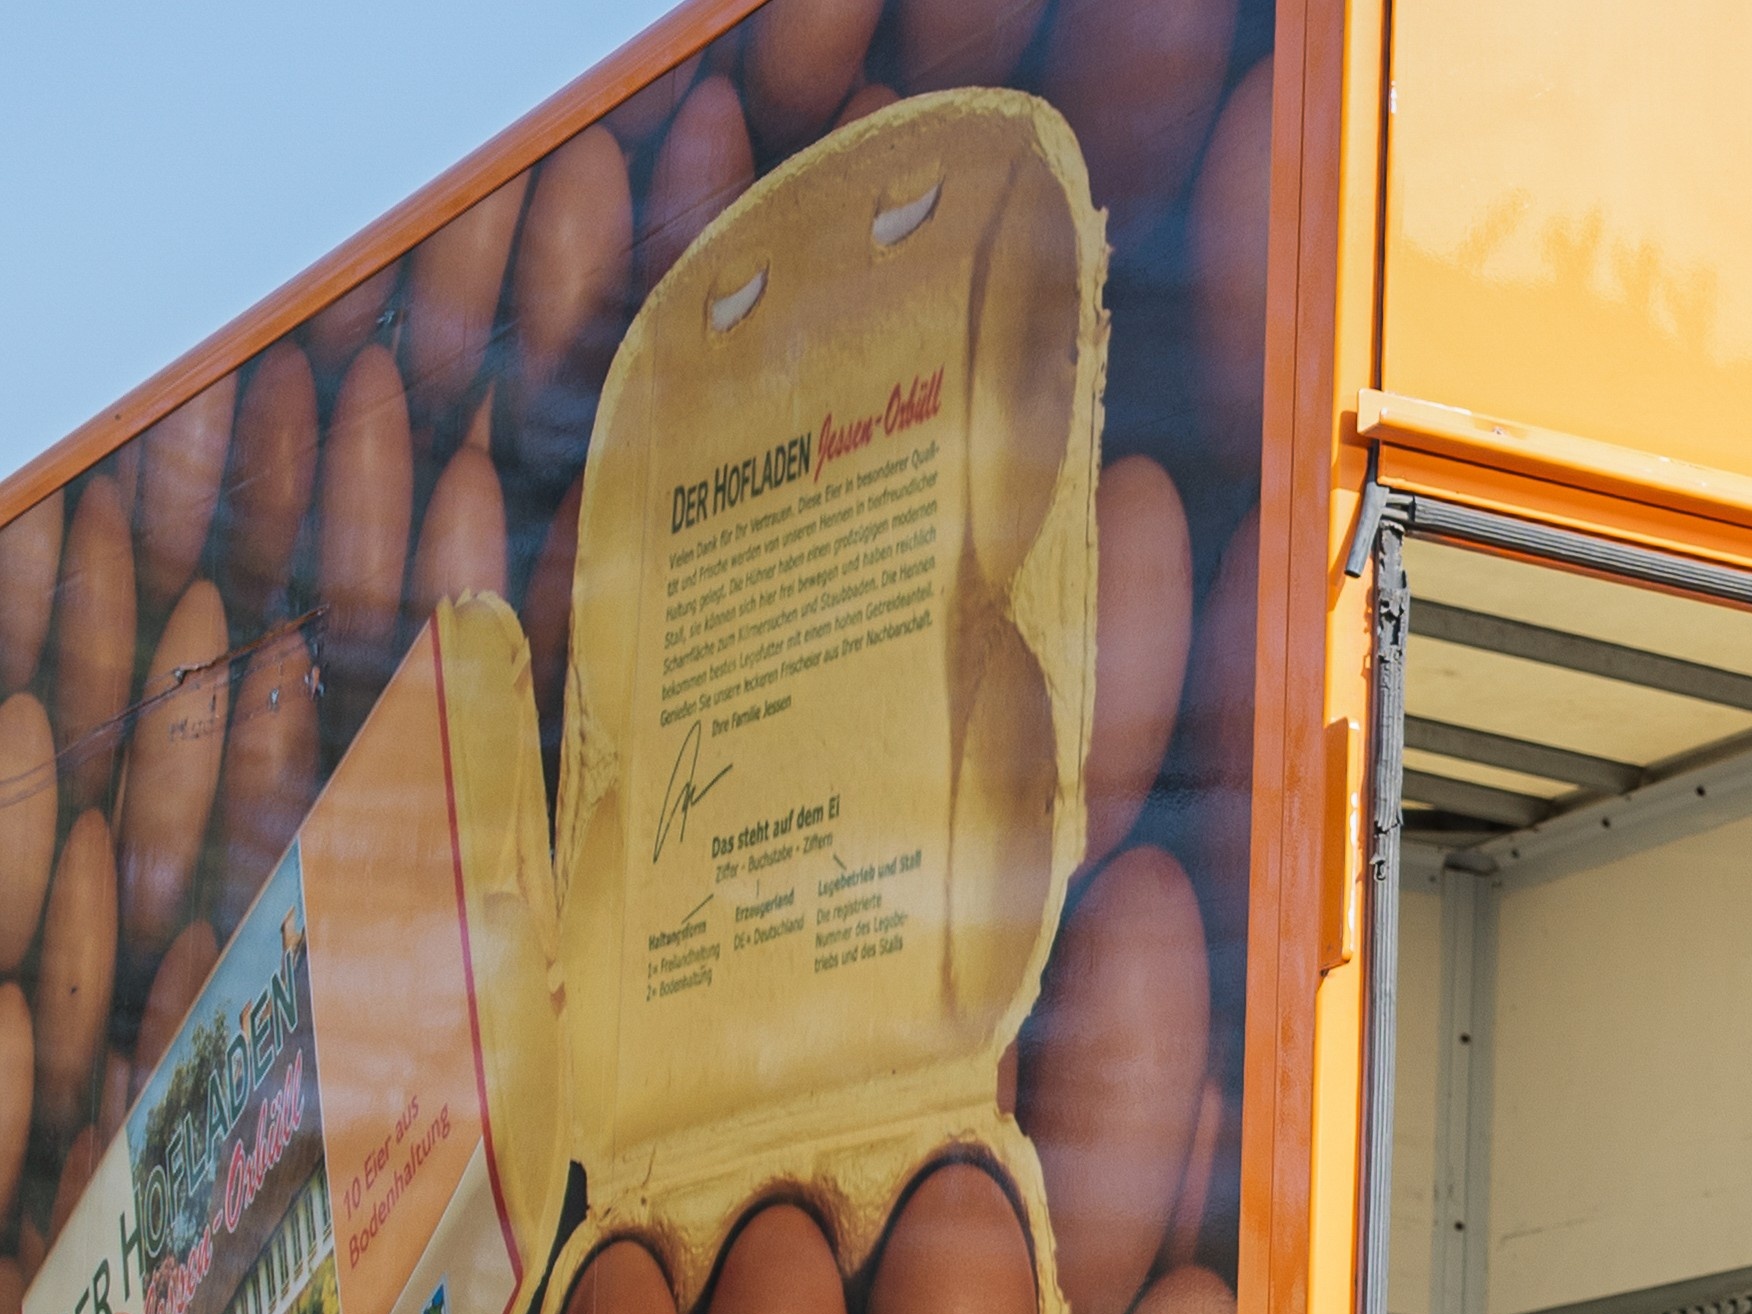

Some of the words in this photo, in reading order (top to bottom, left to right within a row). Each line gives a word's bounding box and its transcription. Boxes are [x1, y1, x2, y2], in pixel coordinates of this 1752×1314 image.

[672, 480, 709, 534] DER
[713, 432, 811, 516] HOFLADEN
[814, 362, 945, 484] Jessen-Oxbüll
[669, 548, 694, 570] Vielen
[696, 535, 717, 559] Dank
[720, 529, 733, 546] für
[735, 523, 748, 540] Ihr
[797, 492, 822, 514] Diese
[824, 483, 843, 503] Eier
[681, 569, 697, 591] und
[730, 544, 761, 567] werden
[764, 536, 779, 553] von
[782, 520, 816, 547] unseren
[819, 506, 853, 529] Hennen
[729, 577, 743, 595] Die
[745, 564, 776, 587] Hühner
[778, 552, 805, 573] haben
[806, 542, 831, 562] einen
[891, 498, 938, 528] modernen
[717, 632, 736, 653] zum
[800, 596, 818, 618] und
[881, 569, 897, 588] Die
[899, 555, 936, 580] Hennen
[738, 595, 756, 617] sich
[759, 590, 777, 608] hier
[779, 583, 794, 598] frei
[797, 565, 838, 593] bewegen
[841, 554, 860, 576] und
[862, 544, 893, 567] haben
[803, 621, 831, 643] einem
[834, 609, 863, 631] hohen
[699, 693, 712, 712] Sie
[713, 682, 741, 706] unsere
[823, 645, 839, 664] aus
[841, 636, 863, 657] Ihrer
[711, 718, 729, 738] Ihre
[731, 706, 761, 729] Familie
[711, 835, 734, 859] Das
[737, 819, 769, 850] steht
[772, 808, 794, 838] auf
[796, 805, 824, 830] dem
[715, 861, 739, 884] Ziffer
[747, 845, 793, 874] Buchstabe
[802, 832, 833, 855] Ziffern
[817, 864, 875, 897] Legebetrieb
[877, 857, 897, 880] und
[899, 848, 922, 873] Stall
[734, 887, 795, 923] Erzeugerland
[753, 915, 804, 946] Deutschland
[816, 907, 831, 926] Die
[833, 893, 882, 921] registrierte
[648, 920, 707, 951] Haltungsform
[814, 953, 839, 974] triebs
[841, 945, 858, 966] und
[860, 943, 877, 960] des
[879, 935, 904, 956] Stalls
[815, 927, 852, 948] Nummer
[855, 921, 870, 937] des
[119, 949, 300, 1302] HOFLADEN
[343, 1176, 361, 1220] 10
[364, 1139, 391, 1190] Eier
[395, 1095, 420, 1144] aus
[348, 1103, 451, 1269] Bodenhaltung
